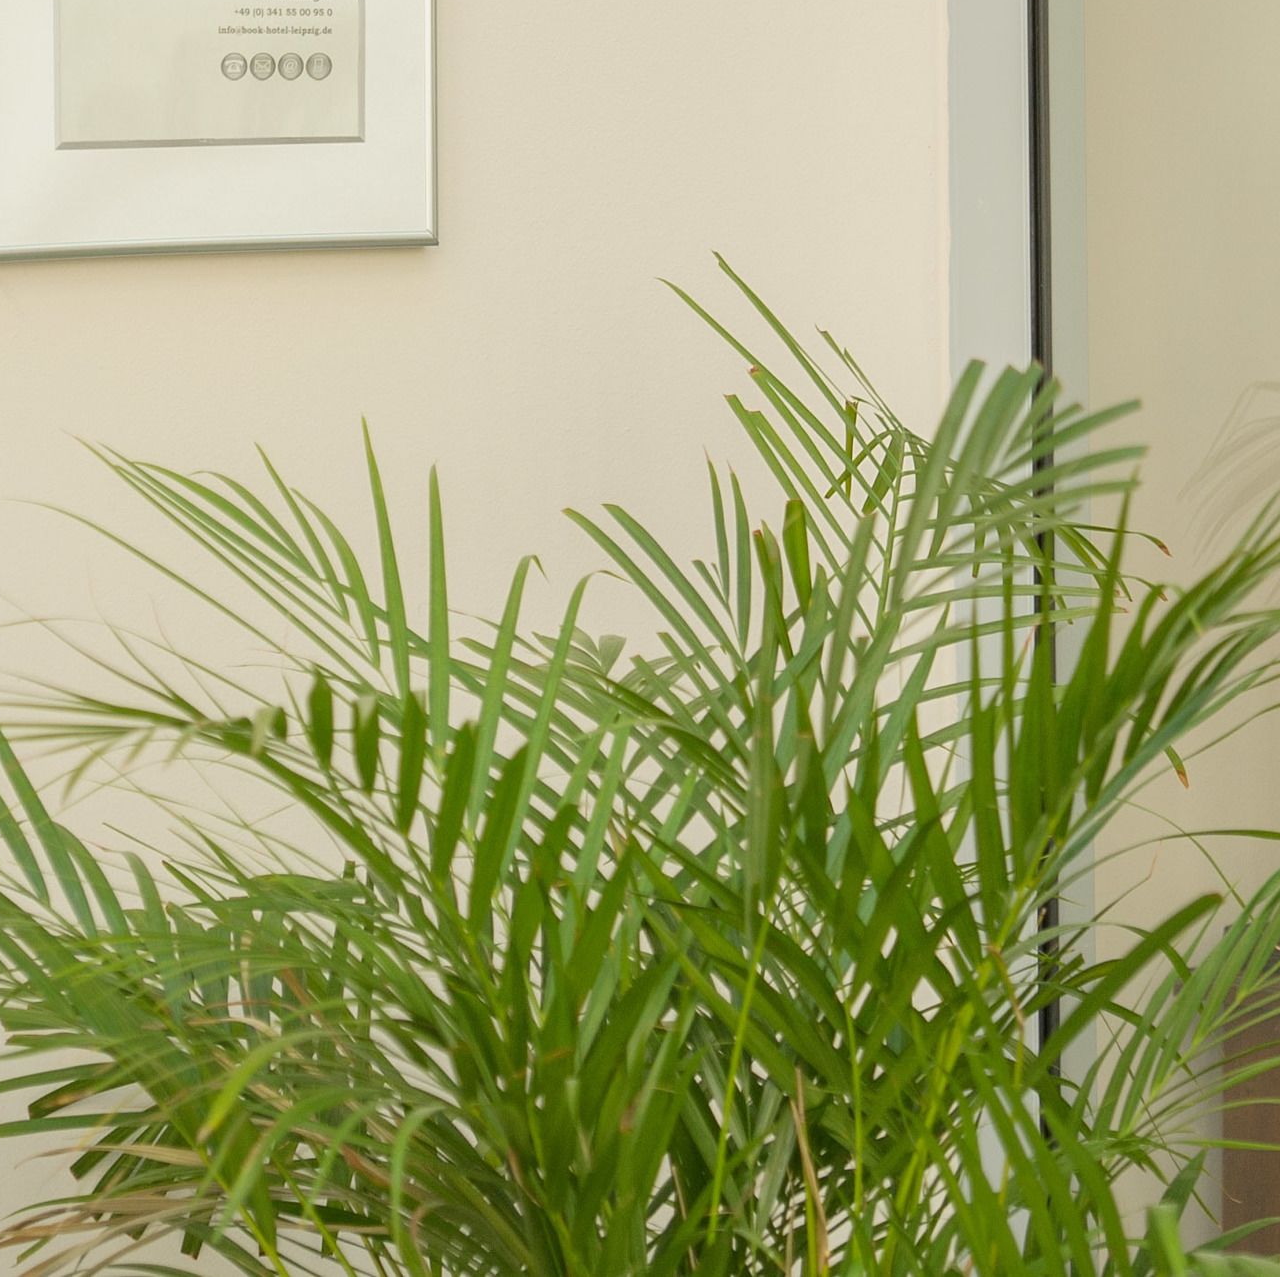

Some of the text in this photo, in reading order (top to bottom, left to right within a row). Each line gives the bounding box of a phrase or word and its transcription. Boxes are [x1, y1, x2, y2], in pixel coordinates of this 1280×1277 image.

[234, 7, 251, 17] +49
[252, 7, 265, 19] (0)
[266, 7, 283, 17] 341
[298, 8, 311, 17] 00
[312, 7, 325, 17] 95
[326, 8, 333, 17] 0
